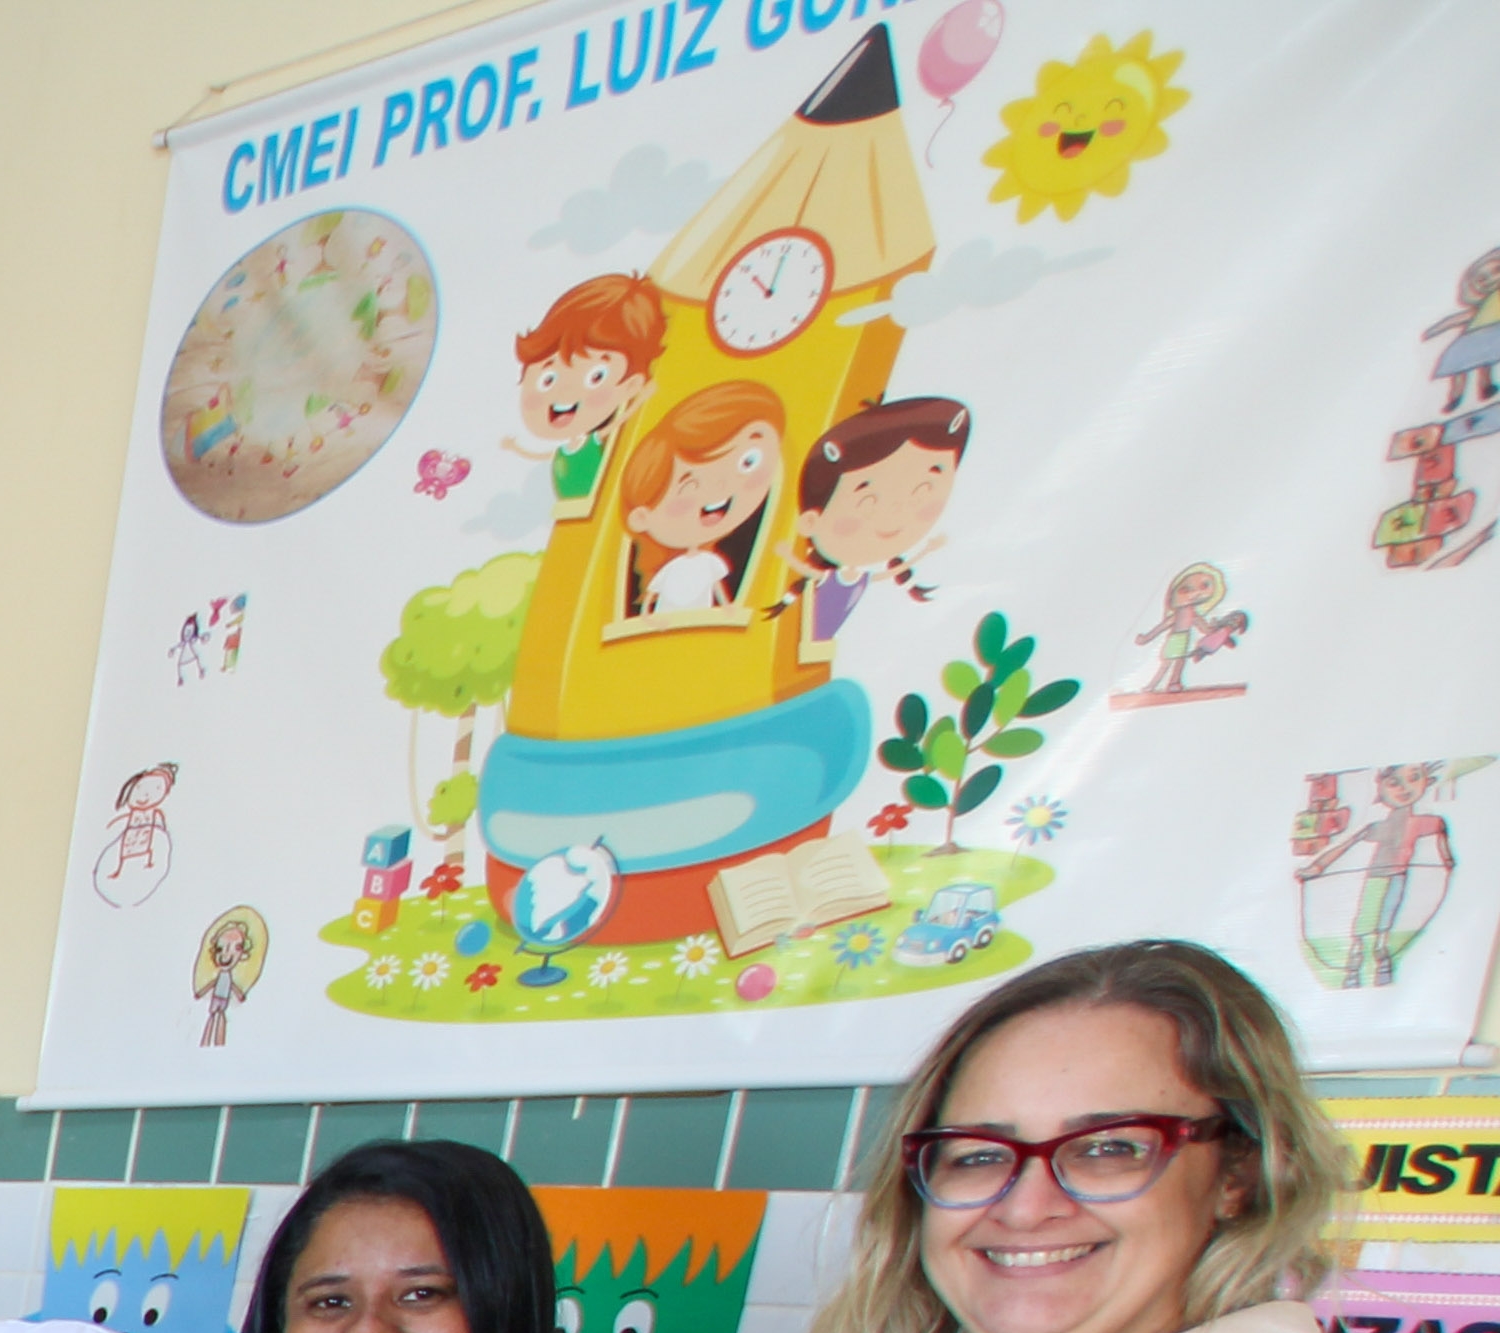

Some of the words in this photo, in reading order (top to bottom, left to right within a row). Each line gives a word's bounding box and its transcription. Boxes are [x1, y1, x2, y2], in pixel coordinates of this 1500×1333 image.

[222, 105, 360, 214] CMEI
[373, 47, 541, 167] PROF.
[564, 0, 721, 111] LUIZ
